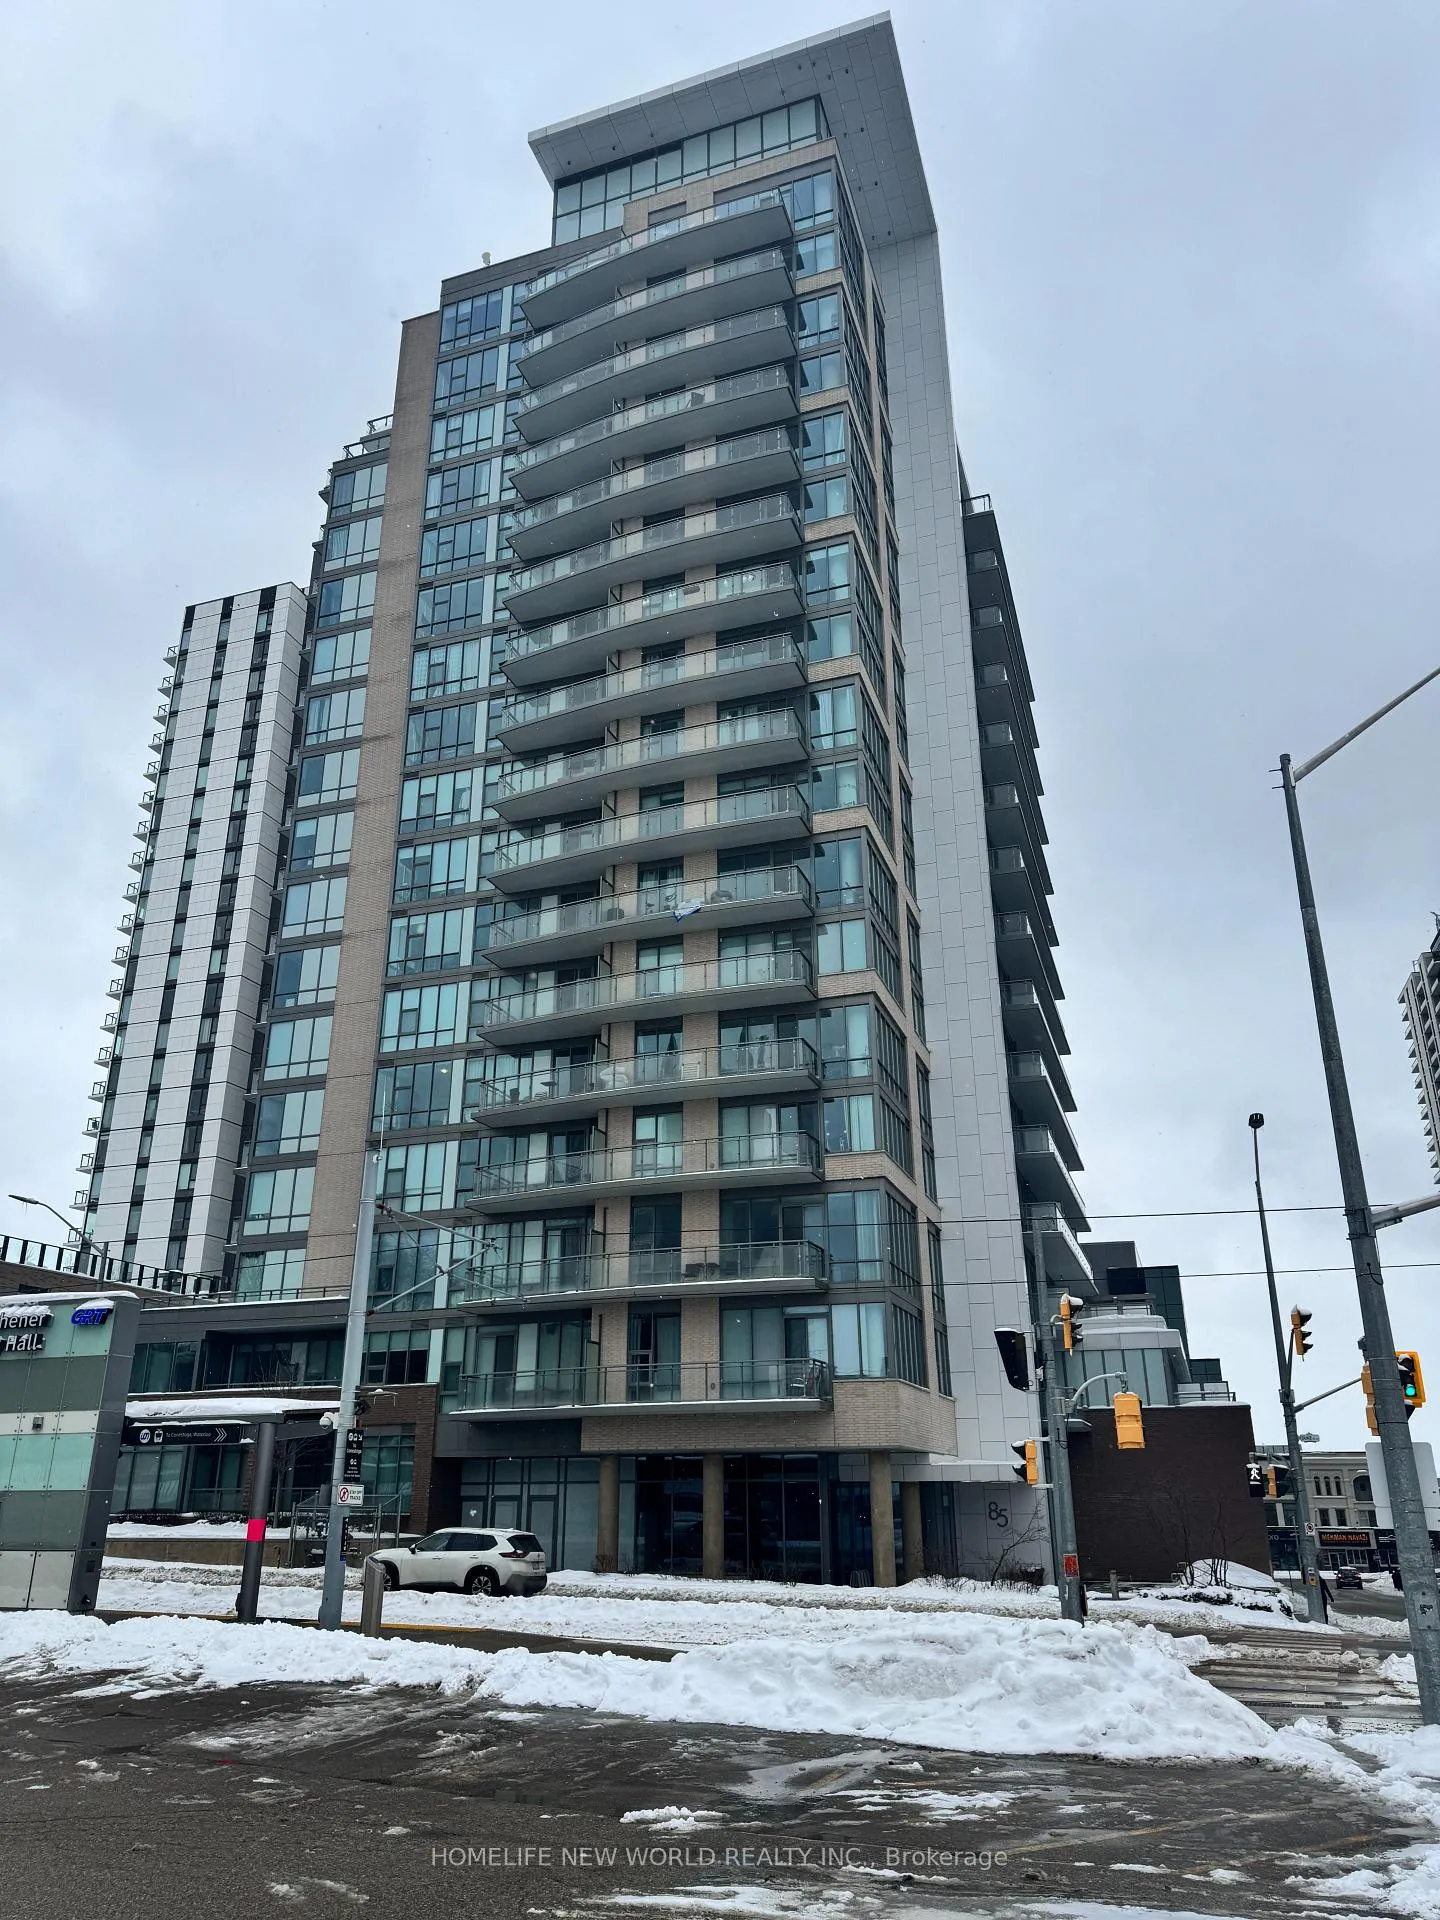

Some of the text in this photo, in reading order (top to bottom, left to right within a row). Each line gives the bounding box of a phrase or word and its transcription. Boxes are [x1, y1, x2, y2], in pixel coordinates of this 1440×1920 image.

[73, 1309, 107, 1325] GRT
[5, 1333, 38, 1352] Hall
[988, 1501, 1008, 1527] 85
